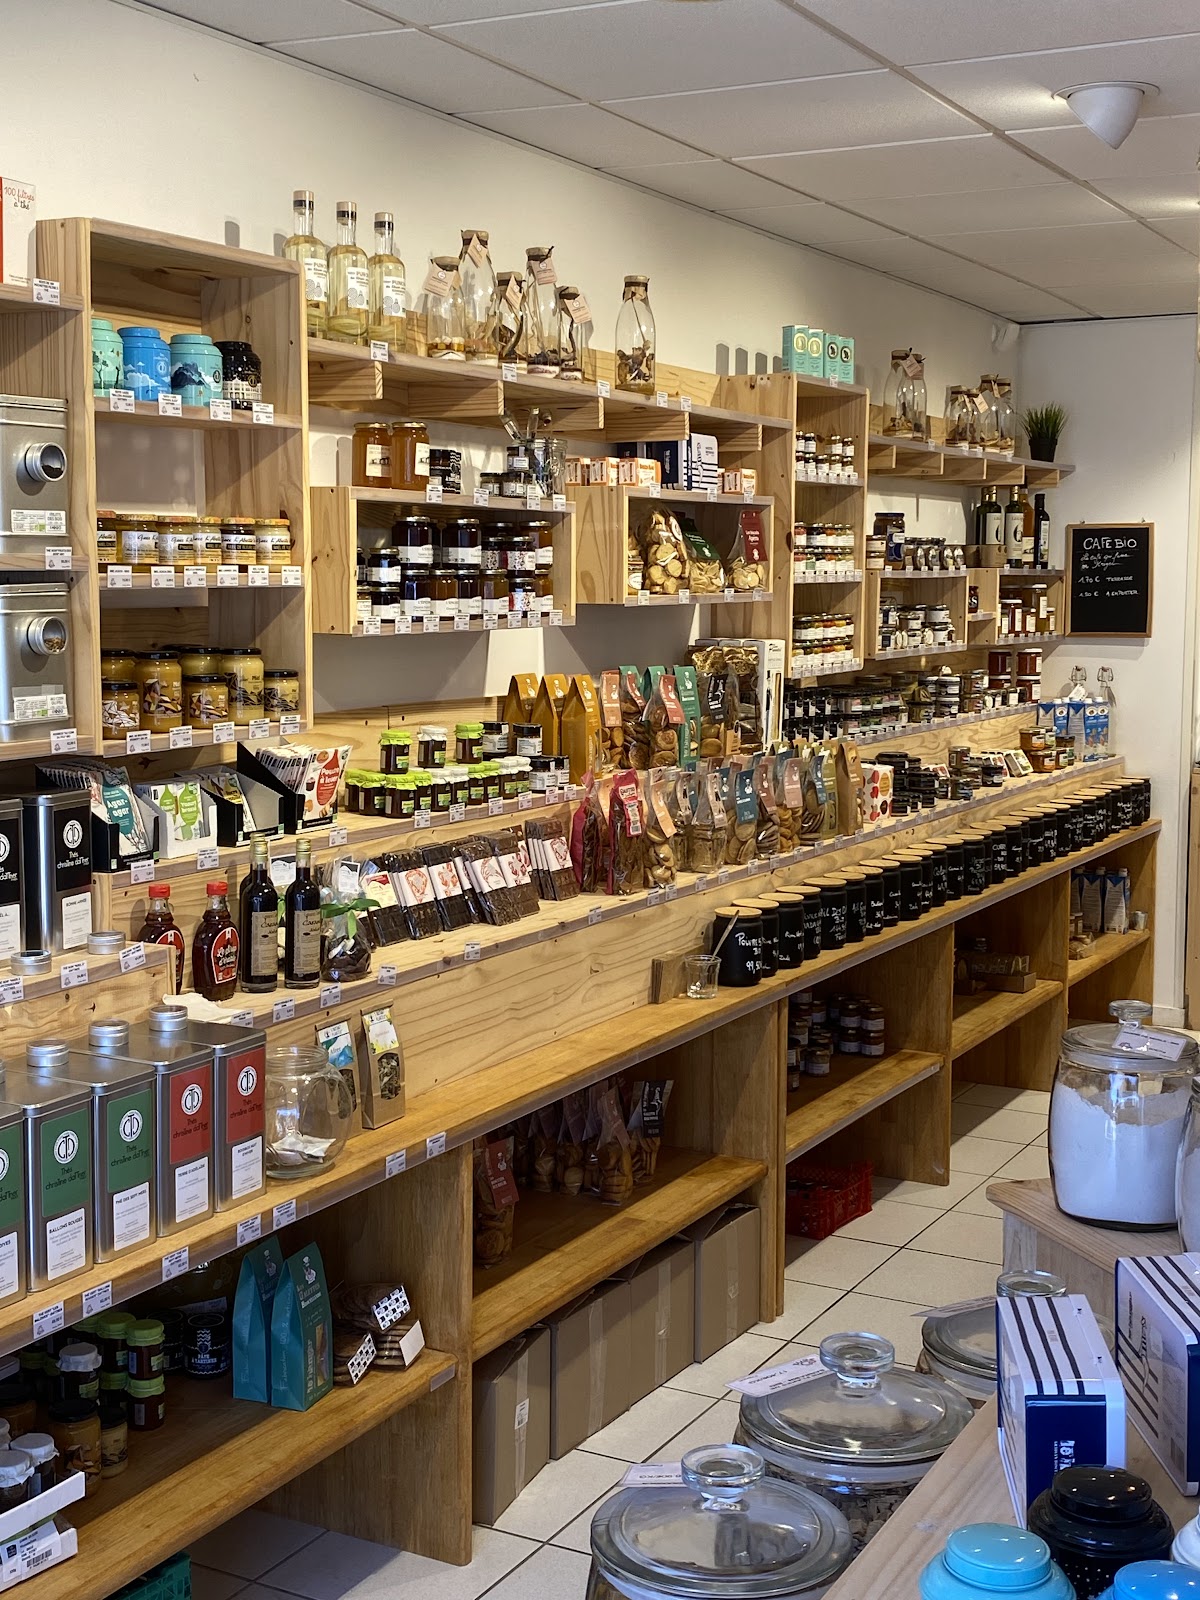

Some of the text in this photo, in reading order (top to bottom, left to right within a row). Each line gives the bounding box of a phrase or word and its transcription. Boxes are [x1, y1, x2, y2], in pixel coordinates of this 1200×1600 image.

[4, 187, 35, 202] 100 filtres
[14, 198, 30, 210] à thé
[106, 798, 128, 809] Agar-
[112, 807, 130, 818] agar
[69, 851, 78, 859] Thés
[49, 1217, 84, 1234] BALLONS ROUGES
